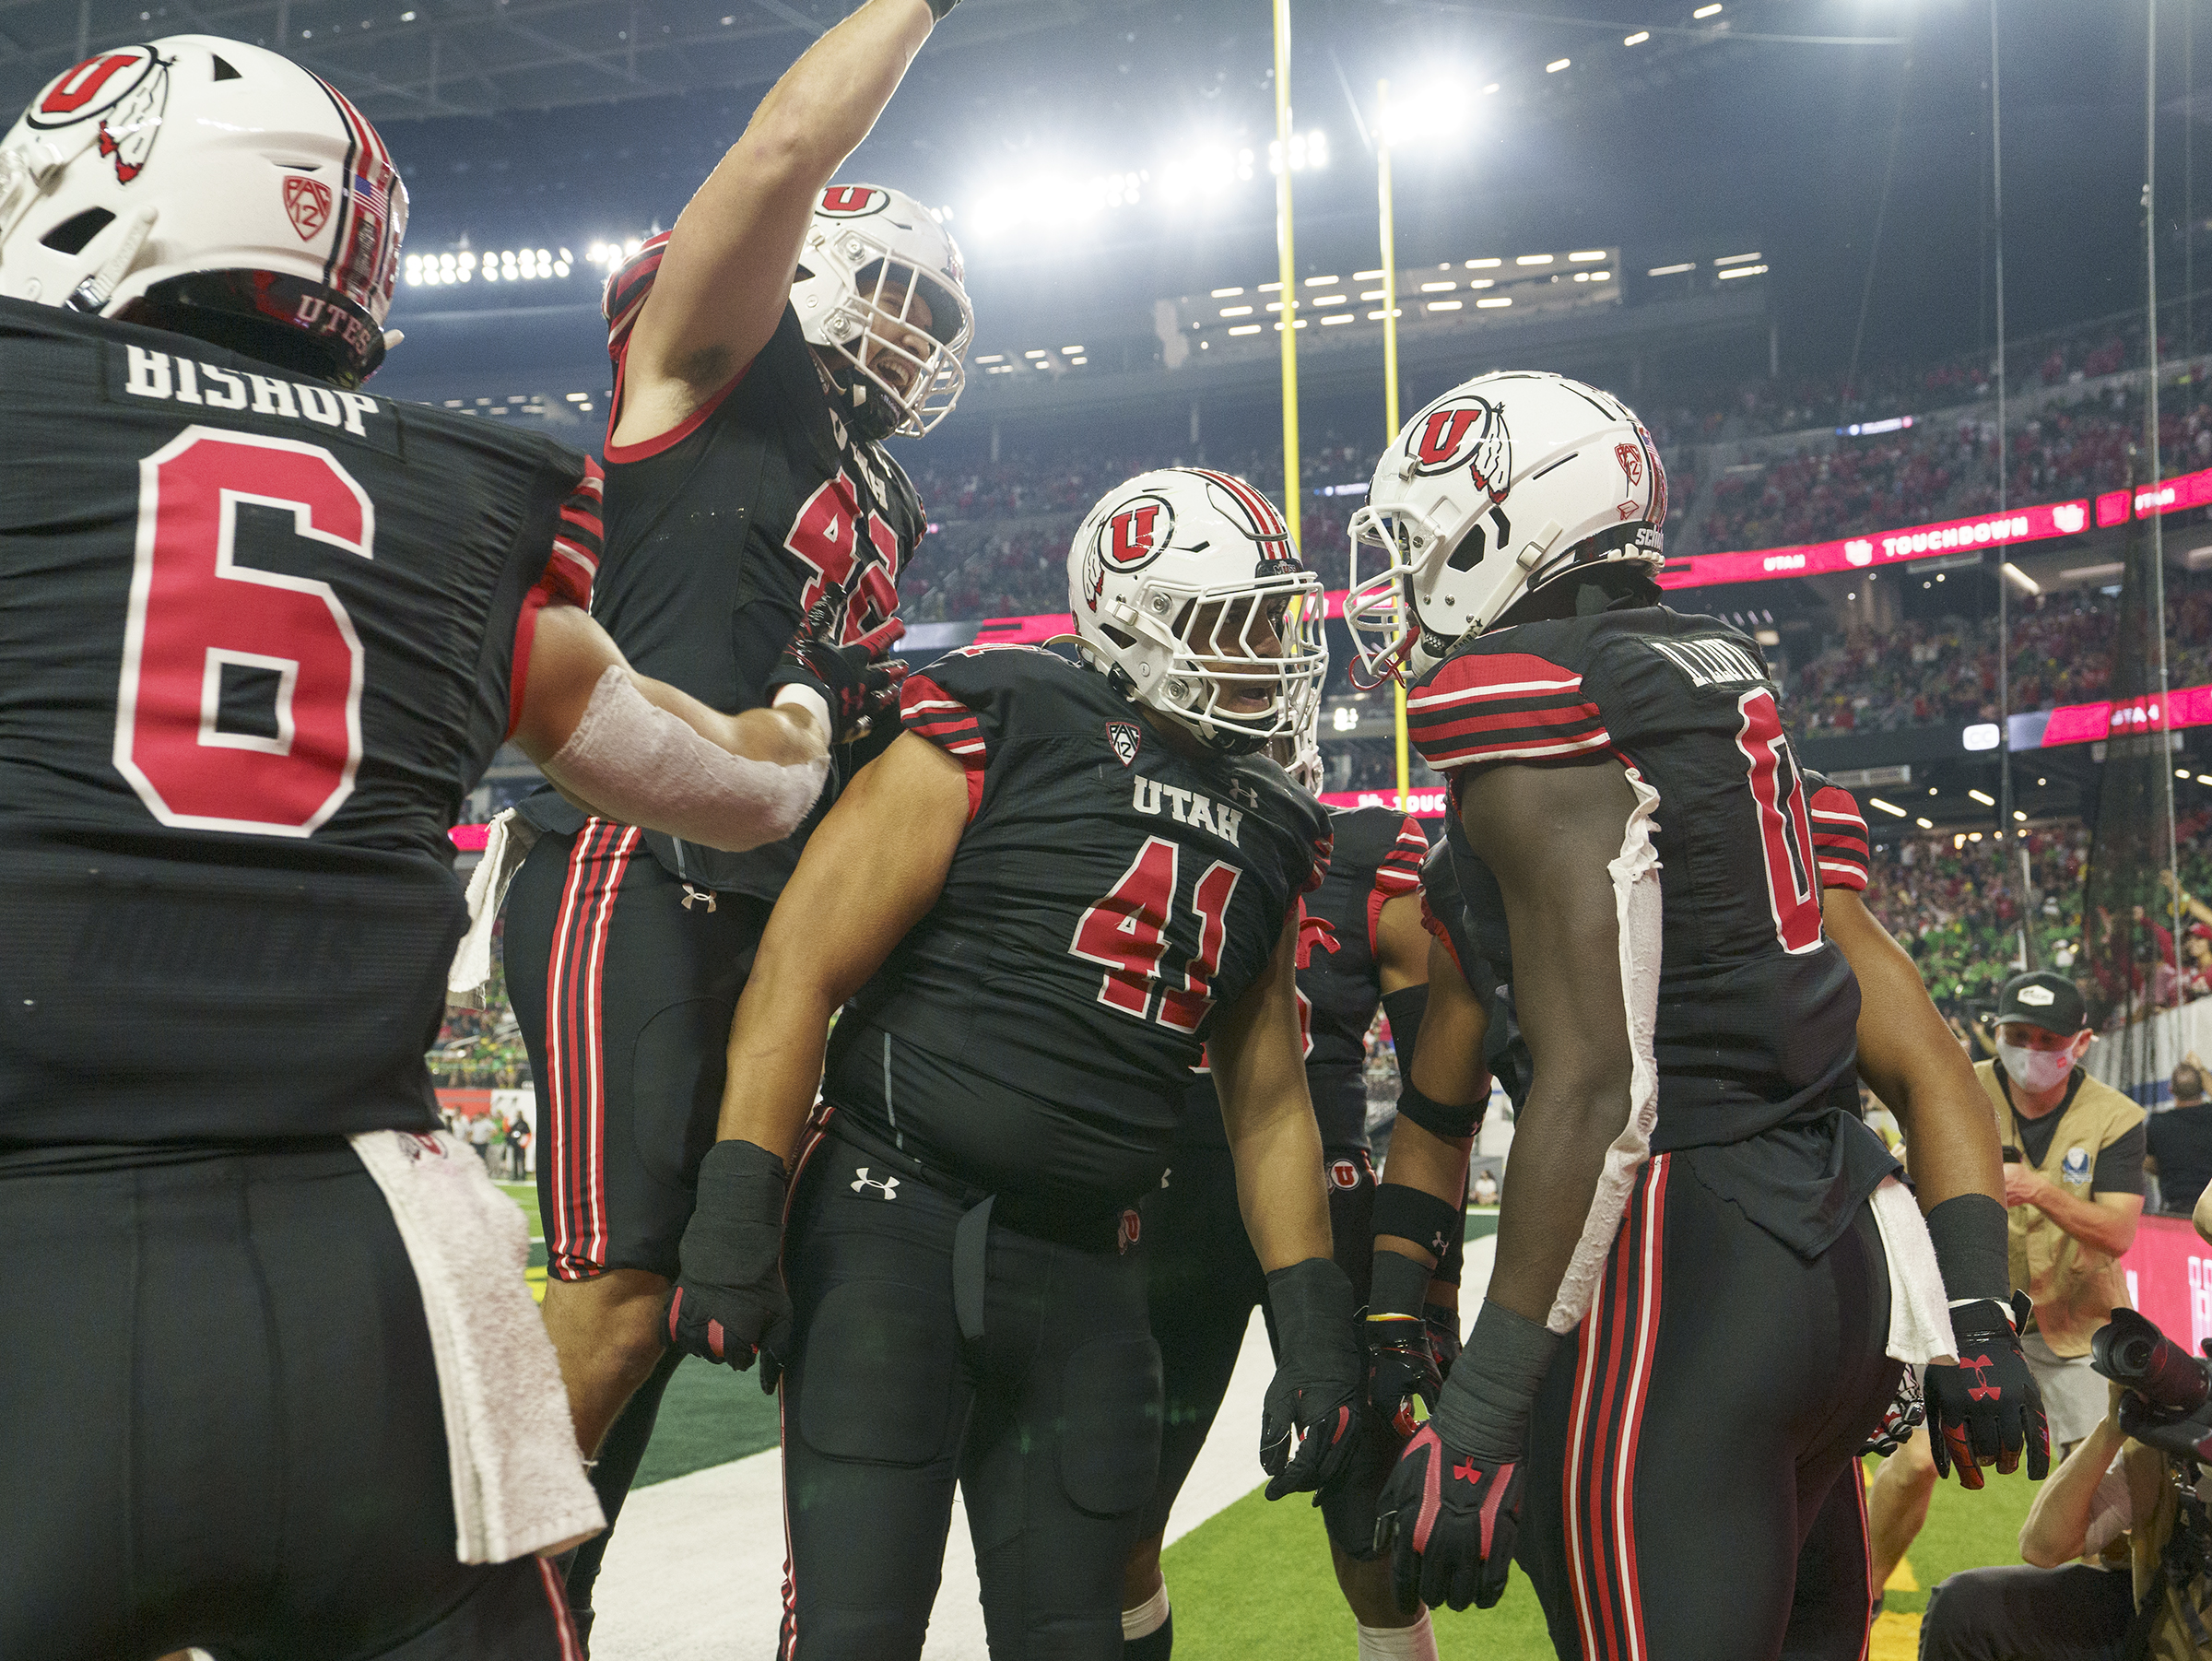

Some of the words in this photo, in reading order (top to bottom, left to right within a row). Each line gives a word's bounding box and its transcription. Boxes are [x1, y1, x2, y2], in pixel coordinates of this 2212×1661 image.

[285, 176, 332, 219] PAC
[295, 203, 320, 228] 12
[821, 186, 877, 212] U
[296, 294, 372, 356] UTES
[125, 344, 379, 438] BISHOP
[1418, 408, 1481, 466] U
[1110, 504, 1160, 564] U
[1763, 554, 1806, 571] UTAH
[1883, 516, 2029, 557] TOUCHDOWN
[113, 424, 374, 838] 6
[1109, 724, 1140, 752] PAC
[1117, 741, 1132, 758] 12
[1133, 774, 1244, 848] UTAH
[1735, 686, 1824, 955] 0
[1067, 834, 1243, 1034] 41
[1334, 1165, 1355, 1186] U
